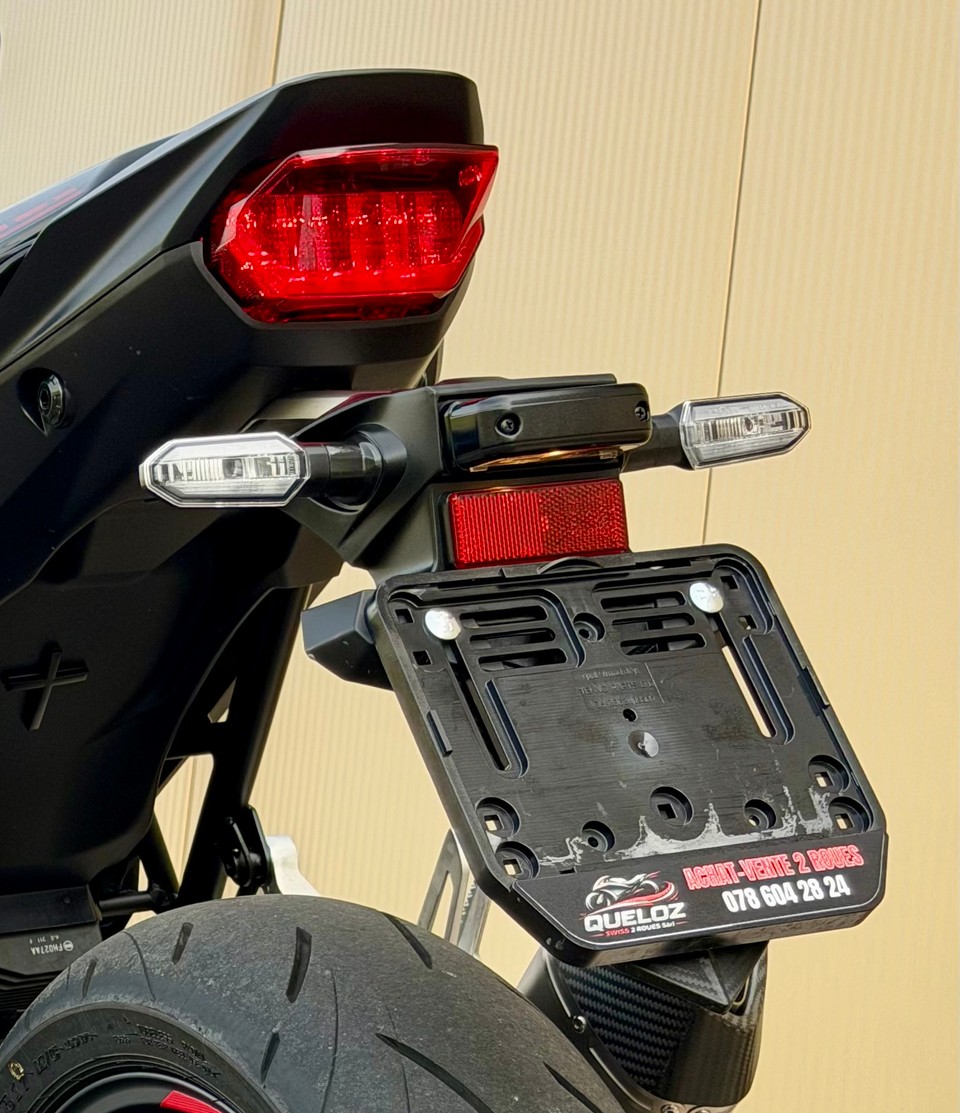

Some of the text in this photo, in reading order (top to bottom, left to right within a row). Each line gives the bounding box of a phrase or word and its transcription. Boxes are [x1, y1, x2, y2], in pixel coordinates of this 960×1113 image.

[683, 844, 865, 890] ACHAT-VENTE 2 ROUES
[721, 874, 851, 912] 078 604 28 24
[584, 902, 687, 932] QUELOZ
[604, 929, 630, 937] SWISS
[636, 924, 661, 932] ROUES
